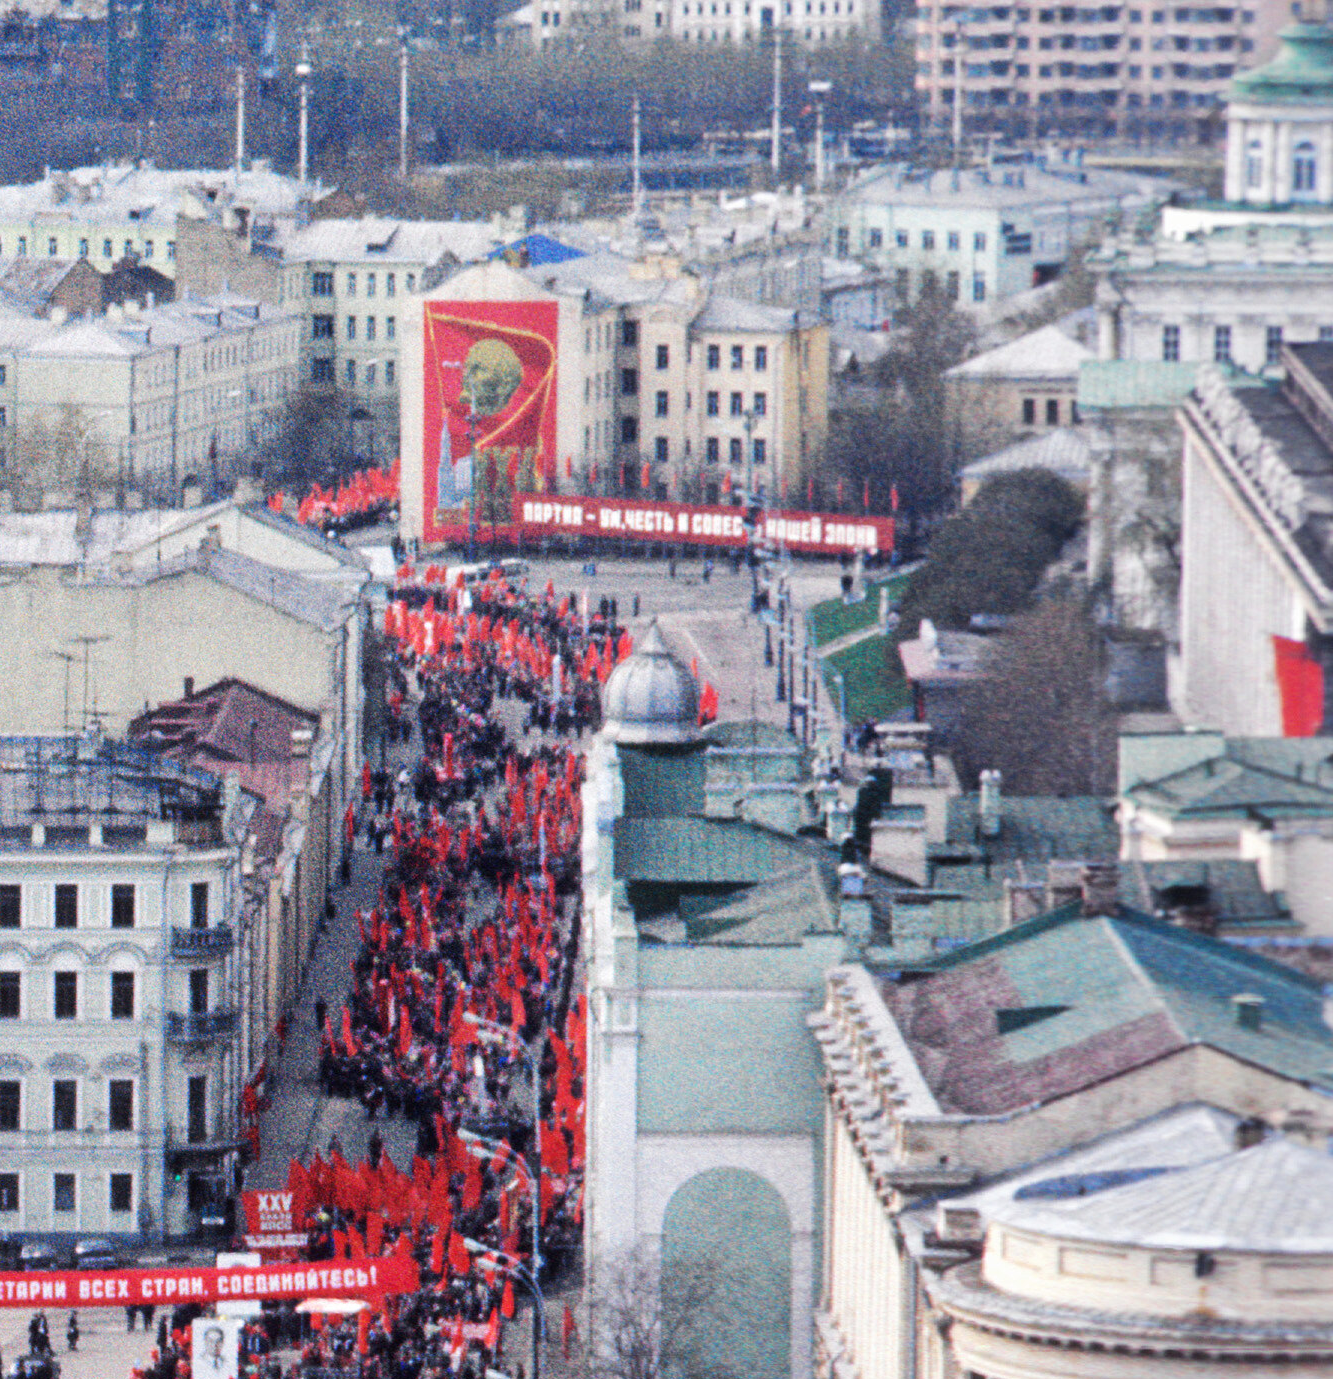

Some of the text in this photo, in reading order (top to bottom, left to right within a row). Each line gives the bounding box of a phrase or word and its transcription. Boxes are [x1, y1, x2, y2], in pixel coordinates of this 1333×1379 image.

[523, 502, 583, 526] ПАРТИЯ
[678, 512, 689, 534] И
[692, 513, 763, 539] СОВЕС
[765, 516, 822, 543] НАШЕЙ
[825, 522, 878, 547] ЭПОХИ
[78, 1279, 129, 1300] ВСЕХ
[217, 1264, 378, 1295] СОЕДИНЯЙТЕСЬ!
